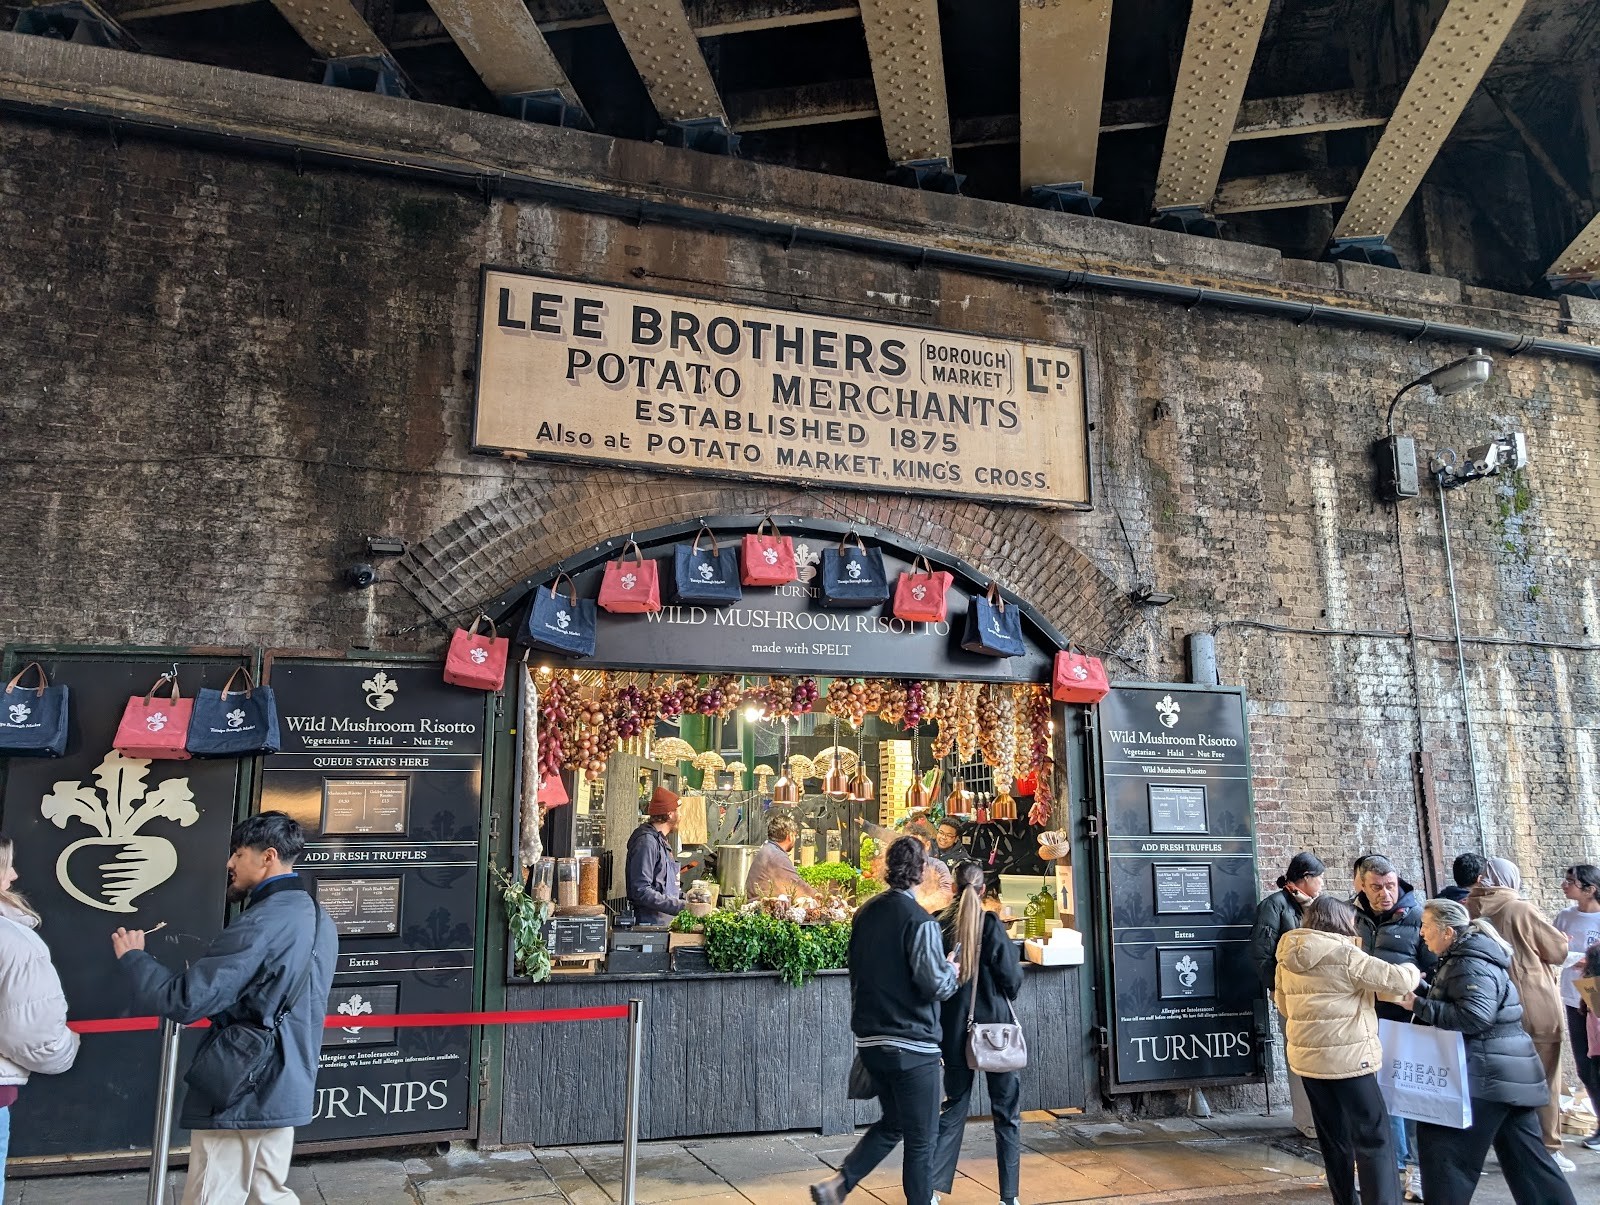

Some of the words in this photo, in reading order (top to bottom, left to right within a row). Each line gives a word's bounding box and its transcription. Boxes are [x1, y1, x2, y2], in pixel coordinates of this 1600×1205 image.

[497, 287, 605, 341] LEE
[631, 305, 907, 377] BROTHERS
[566, 348, 741, 398] POTATO
[772, 373, 1018, 429] MERCHANTS
[636, 399, 866, 443] ESTABLISHED
[890, 427, 958, 453] 1875
[536, 421, 592, 445] Also
[604, 432, 630, 449] at
[647, 433, 761, 463] POTATO
[892, 458, 961, 482] KING'S
[975, 466, 1051, 490] CROSS.
[774, 586, 819, 598] TURNI
[646, 605, 708, 625] WILD
[714, 608, 851, 633] MUSHROOM
[752, 642, 781, 654] made
[785, 643, 809, 655] with
[812, 643, 852, 656] SPELT
[285, 716, 326, 732] Wild
[330, 716, 416, 733] Mushroom
[419, 718, 476, 734] Risotto
[301, 736, 350, 747] Vegetarian
[367, 737, 393, 745] Halal
[413, 737, 431, 746] Nut
[434, 737, 454, 746] Free
[1108, 730, 1136, 744] Wild
[1138, 731, 1196, 746] Mushroom
[1198, 734, 1237, 747] Risotto
[1122, 748, 1156, 757] Vegetarian
[1166, 749, 1184, 757] Halal
[313, 758, 353, 767] QUEUE
[355, 758, 396, 766] STARTS
[399, 758, 429, 766] HERE
[1142, 765, 1156, 774] Wild
[1157, 766, 1186, 774] Mushroom
[1187, 767, 1206, 775] Risotto
[304, 852, 330, 862] ADD
[332, 852, 370, 860] FRESH
[372, 850, 427, 860] TRUFFLES
[348, 958, 379, 967] Extras
[1130, 1031, 1251, 1063] TURNIPS
[318, 1054, 346, 1062] Allergies
[358, 1050, 400, 1059] Intolerances?
[1392, 1059, 1448, 1078] BREAD
[1392, 1070, 1448, 1088] AHEAD
